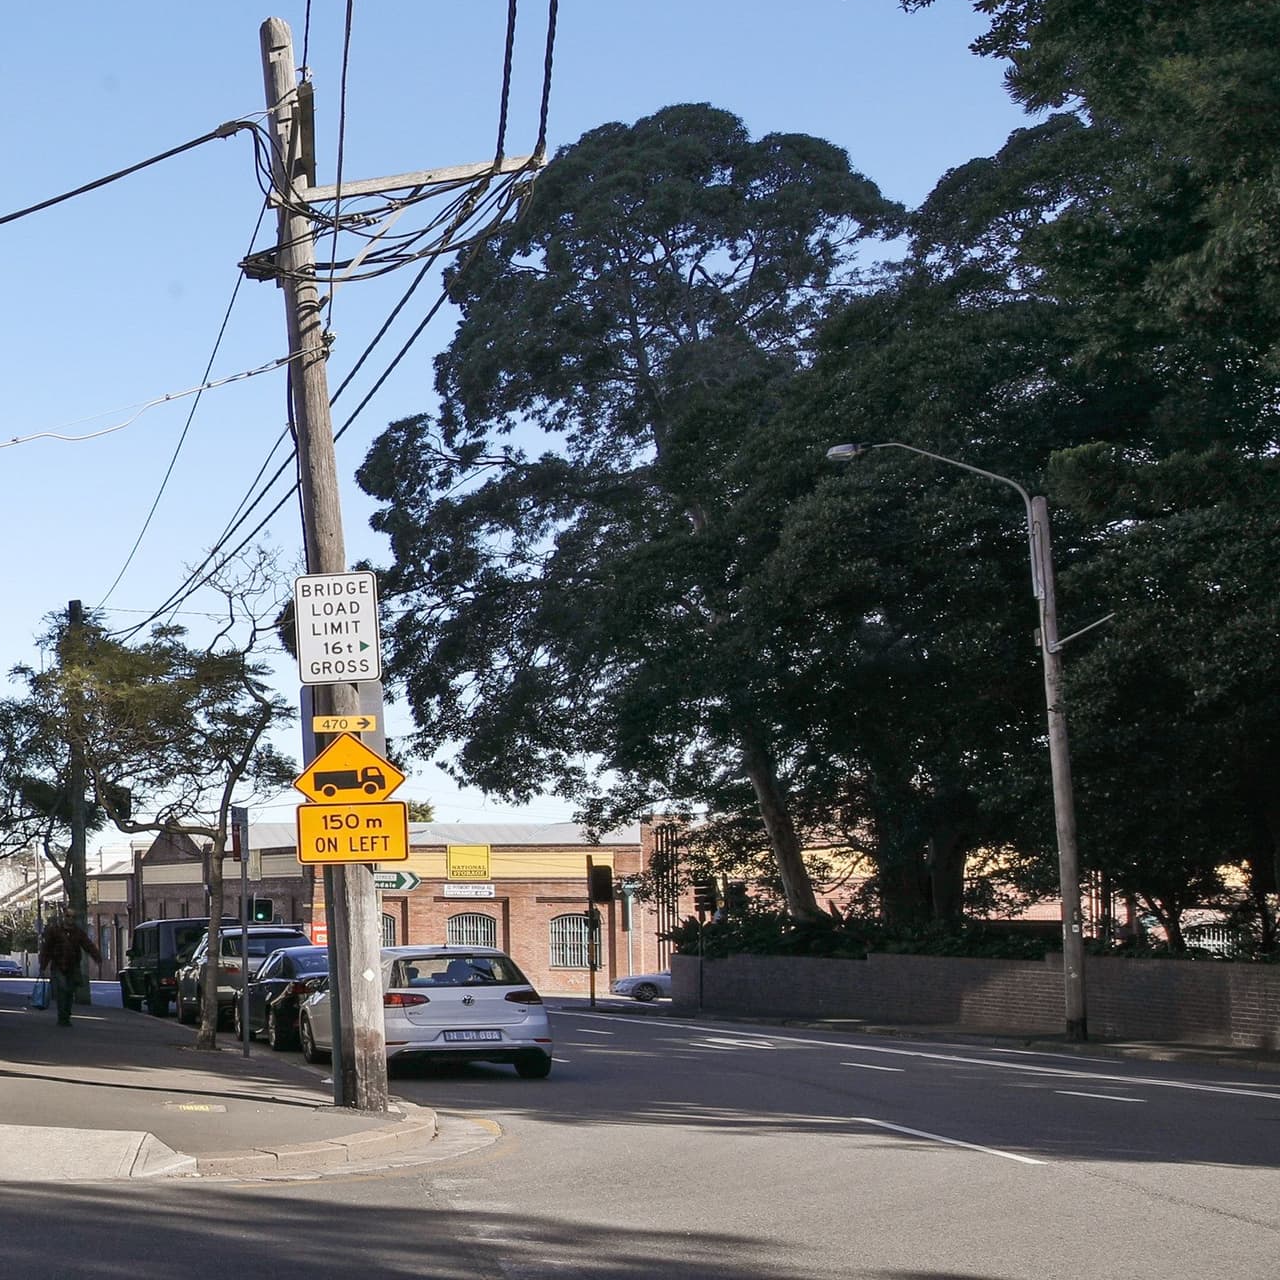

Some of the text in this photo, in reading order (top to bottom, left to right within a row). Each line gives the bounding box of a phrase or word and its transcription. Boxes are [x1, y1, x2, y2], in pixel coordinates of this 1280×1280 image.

[301, 581, 369, 597] BRIDGE
[311, 601, 360, 616] LOAD
[312, 620, 361, 636] LIMIT
[310, 659, 369, 675] GROSS
[322, 719, 348, 729] 470
[322, 814, 383, 830] 150 m
[315, 836, 390, 853] ON LEFT
